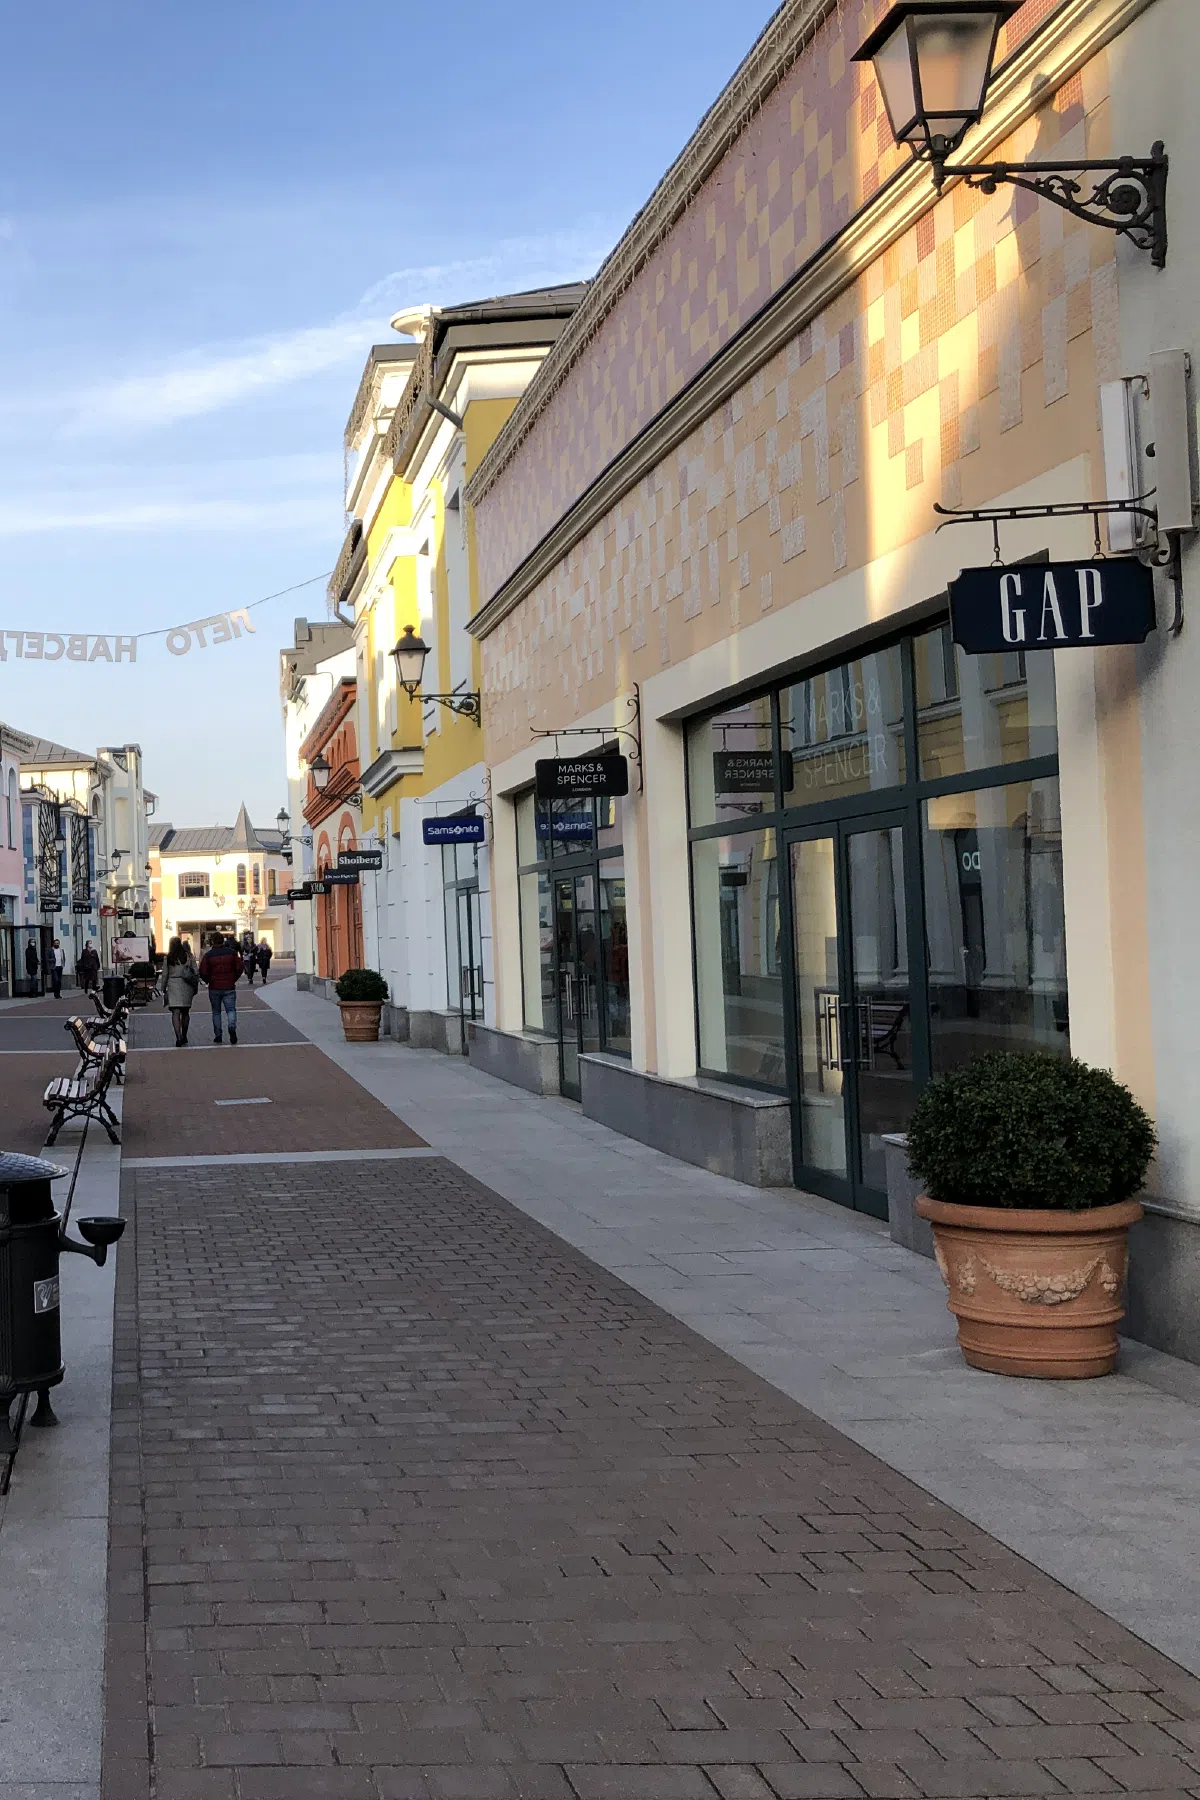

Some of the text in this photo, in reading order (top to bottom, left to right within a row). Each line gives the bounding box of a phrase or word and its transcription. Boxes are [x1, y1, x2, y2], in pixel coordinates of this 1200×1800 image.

[999, 568, 1103, 643] GAP
[804, 733, 888, 789] SPENCER
[558, 763, 604, 773] MARKS &
[557, 774, 607, 785] SPENCER
[427, 825, 480, 835] Samsonite
[338, 856, 381, 866] Shoiberg
